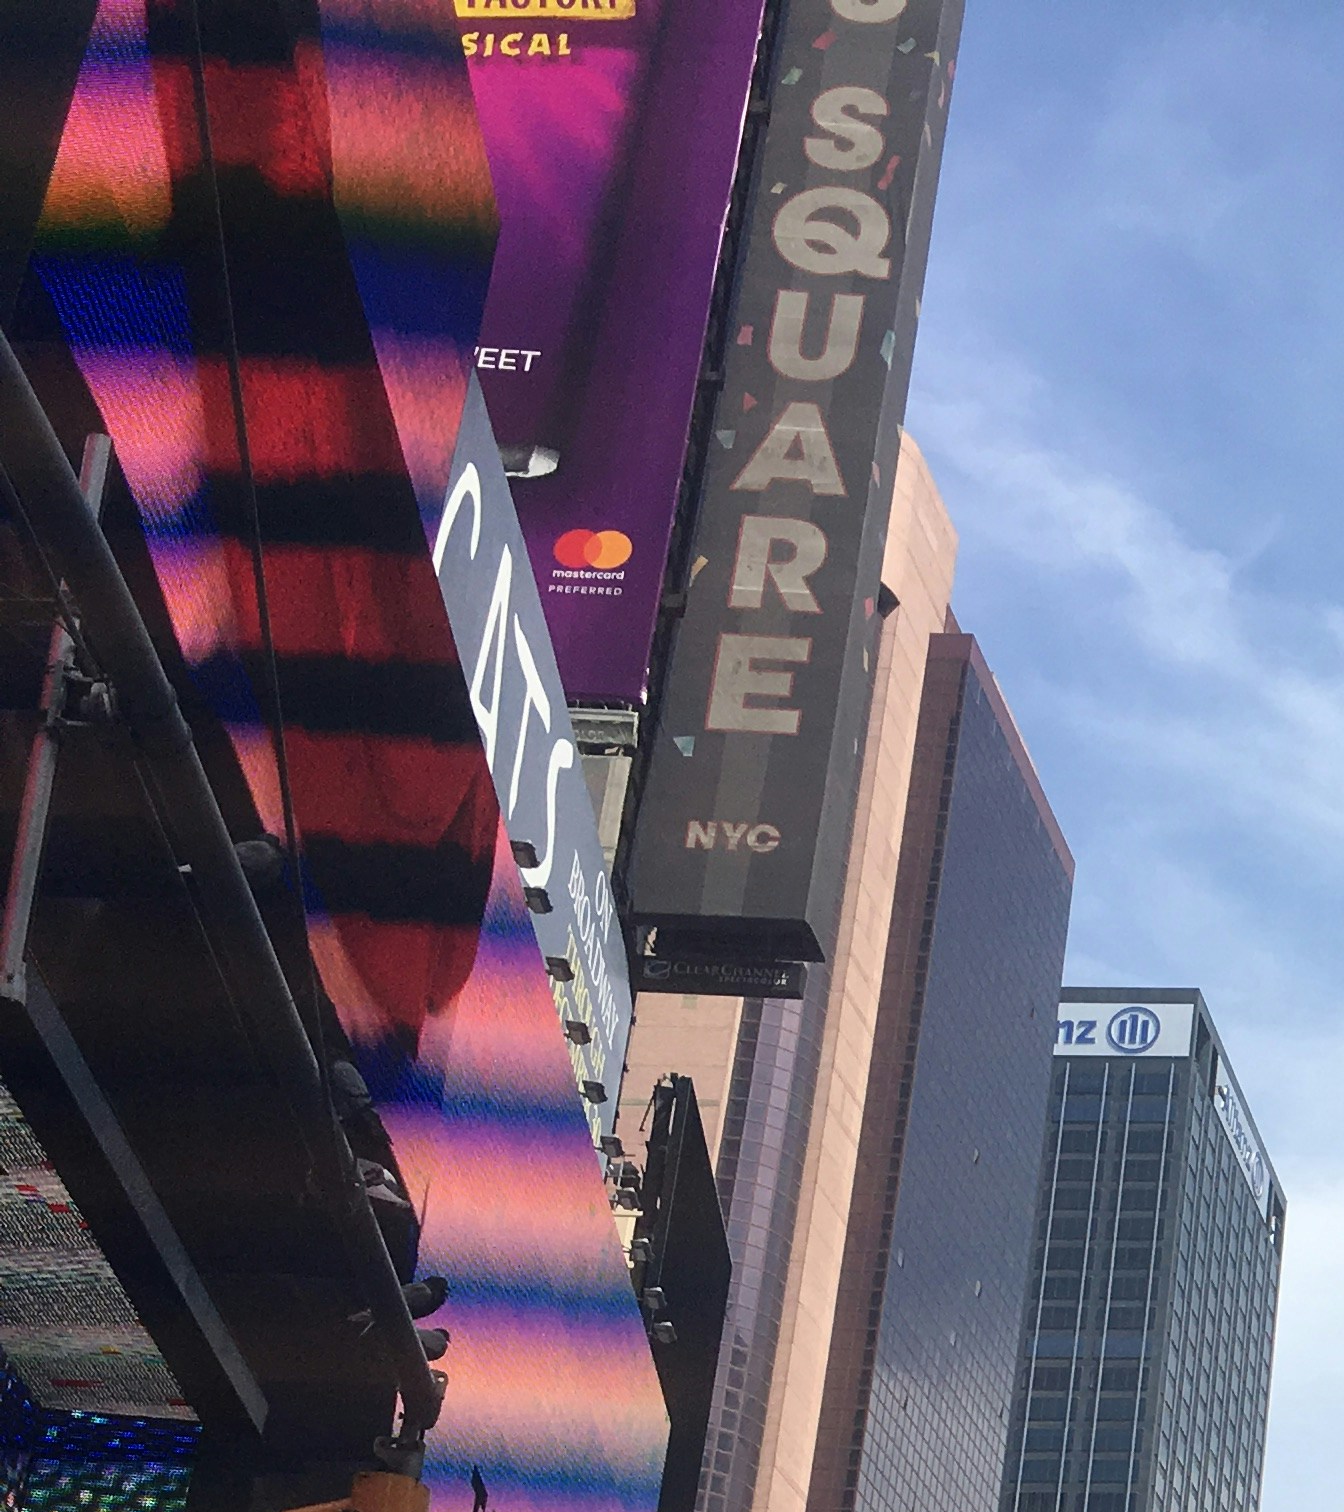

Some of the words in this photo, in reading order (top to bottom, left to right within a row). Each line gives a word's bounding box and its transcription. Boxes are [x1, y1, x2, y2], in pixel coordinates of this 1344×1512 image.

[473, 346, 542, 372] EET
[705, 84, 891, 736] SQUARE
[552, 569, 625, 580] mastercard
[548, 584, 623, 596] PREFERRED
[685, 821, 781, 852] NYC
